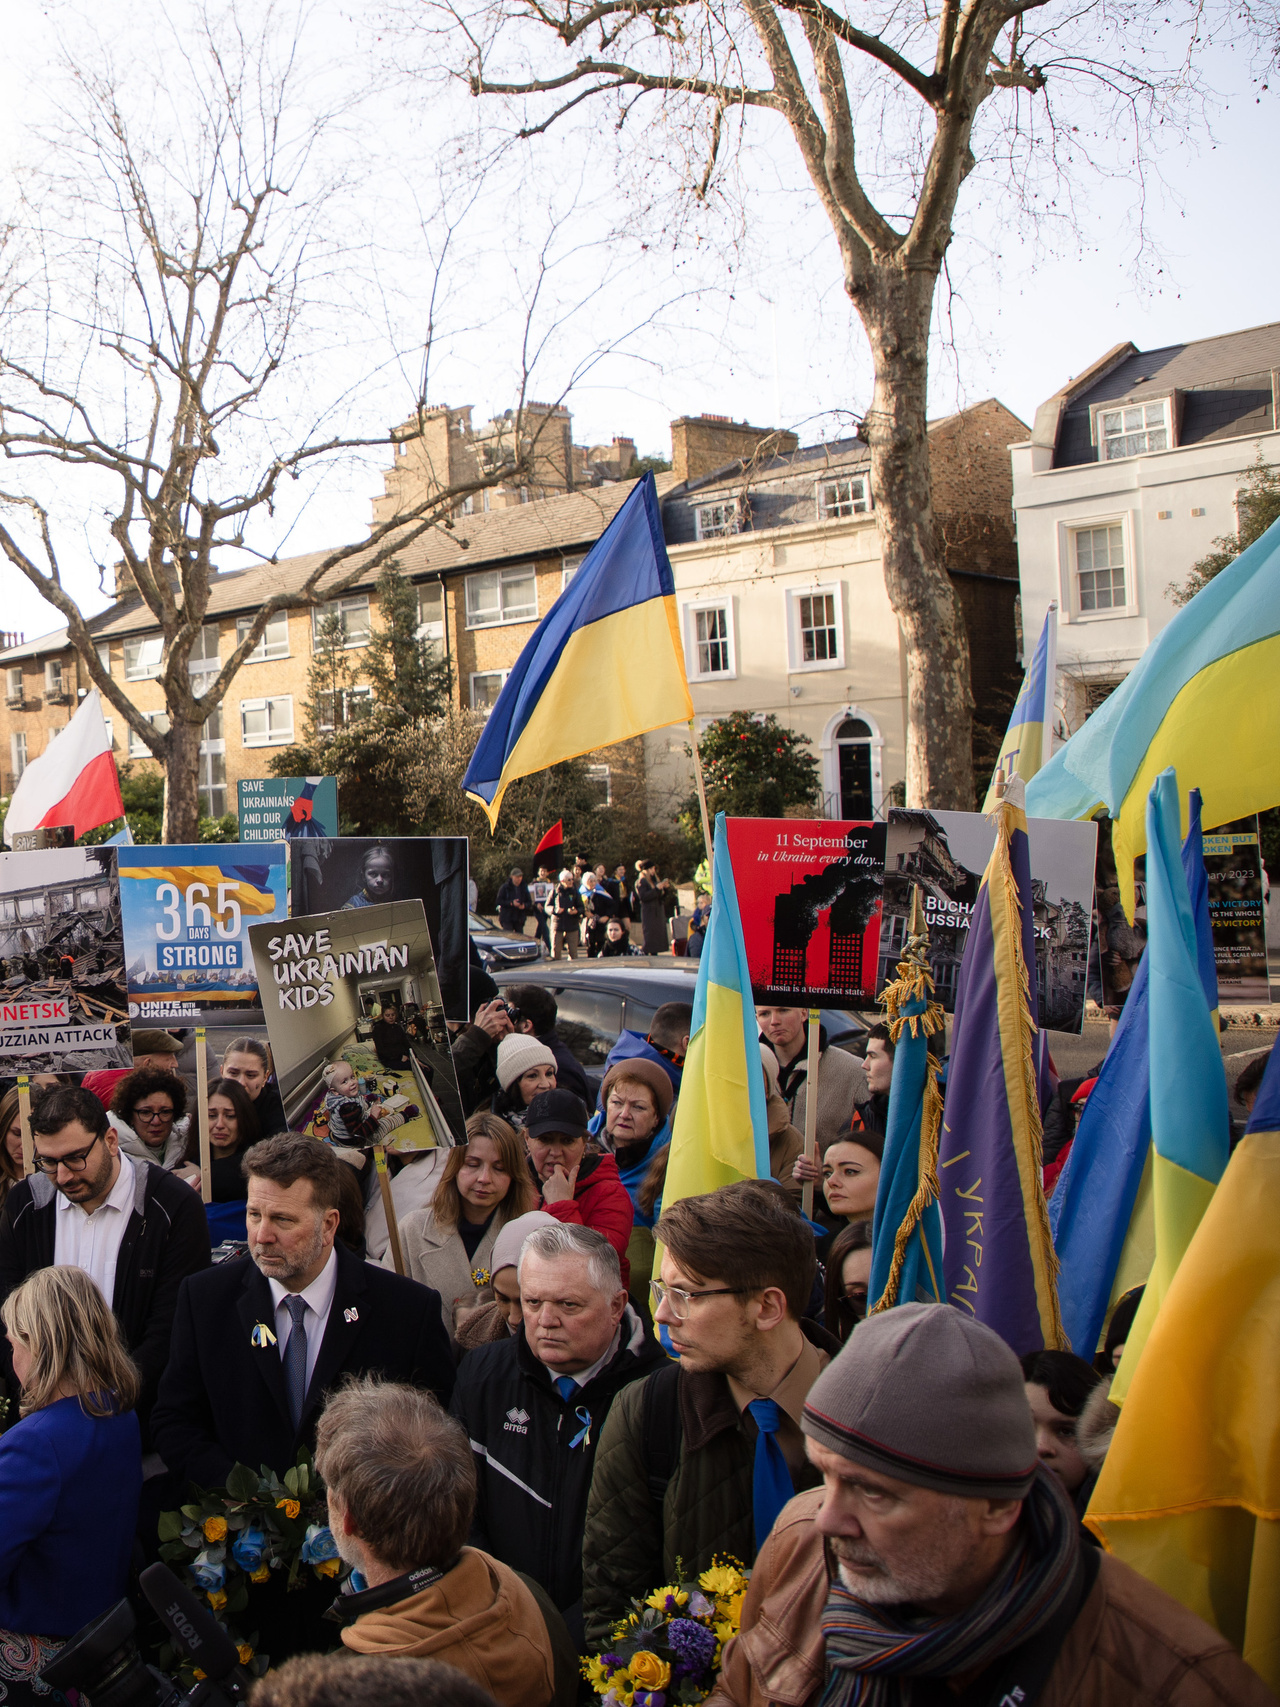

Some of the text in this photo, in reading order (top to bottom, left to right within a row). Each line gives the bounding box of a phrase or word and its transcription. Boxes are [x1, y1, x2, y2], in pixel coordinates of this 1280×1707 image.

[242, 781, 264, 792] SAVE
[243, 796, 295, 808] UKRAINIANS
[243, 812, 281, 824] AND OUR
[244, 828, 286, 840] CHILDREN
[776, 833, 868, 850] 11 September
[757, 851, 769, 861] in
[772, 851, 817, 863] Ukraine
[819, 855, 851, 866] every
[1229, 870, 1255, 879] 2023
[155, 882, 241, 940] 365
[923, 911, 971, 929] USSIA
[1223, 919, 1261, 927] VICTORY
[188, 927, 210, 940] DAYS
[267, 928, 332, 961] SAVE
[162, 945, 237, 967] STRONG
[273, 944, 409, 985] UKRAINIAN
[279, 982, 334, 1010] KIDS
[766, 984, 790, 992] russia
[792, 984, 799, 992] is
[808, 986, 843, 994] terrorist
[844, 988, 865, 996] state
[140, 1001, 181, 1010] UNITE
[140, 1008, 201, 1018] UKRAINE
[54, 1028, 112, 1044] ATTACK
[165, 1602, 203, 1650] RØDE
